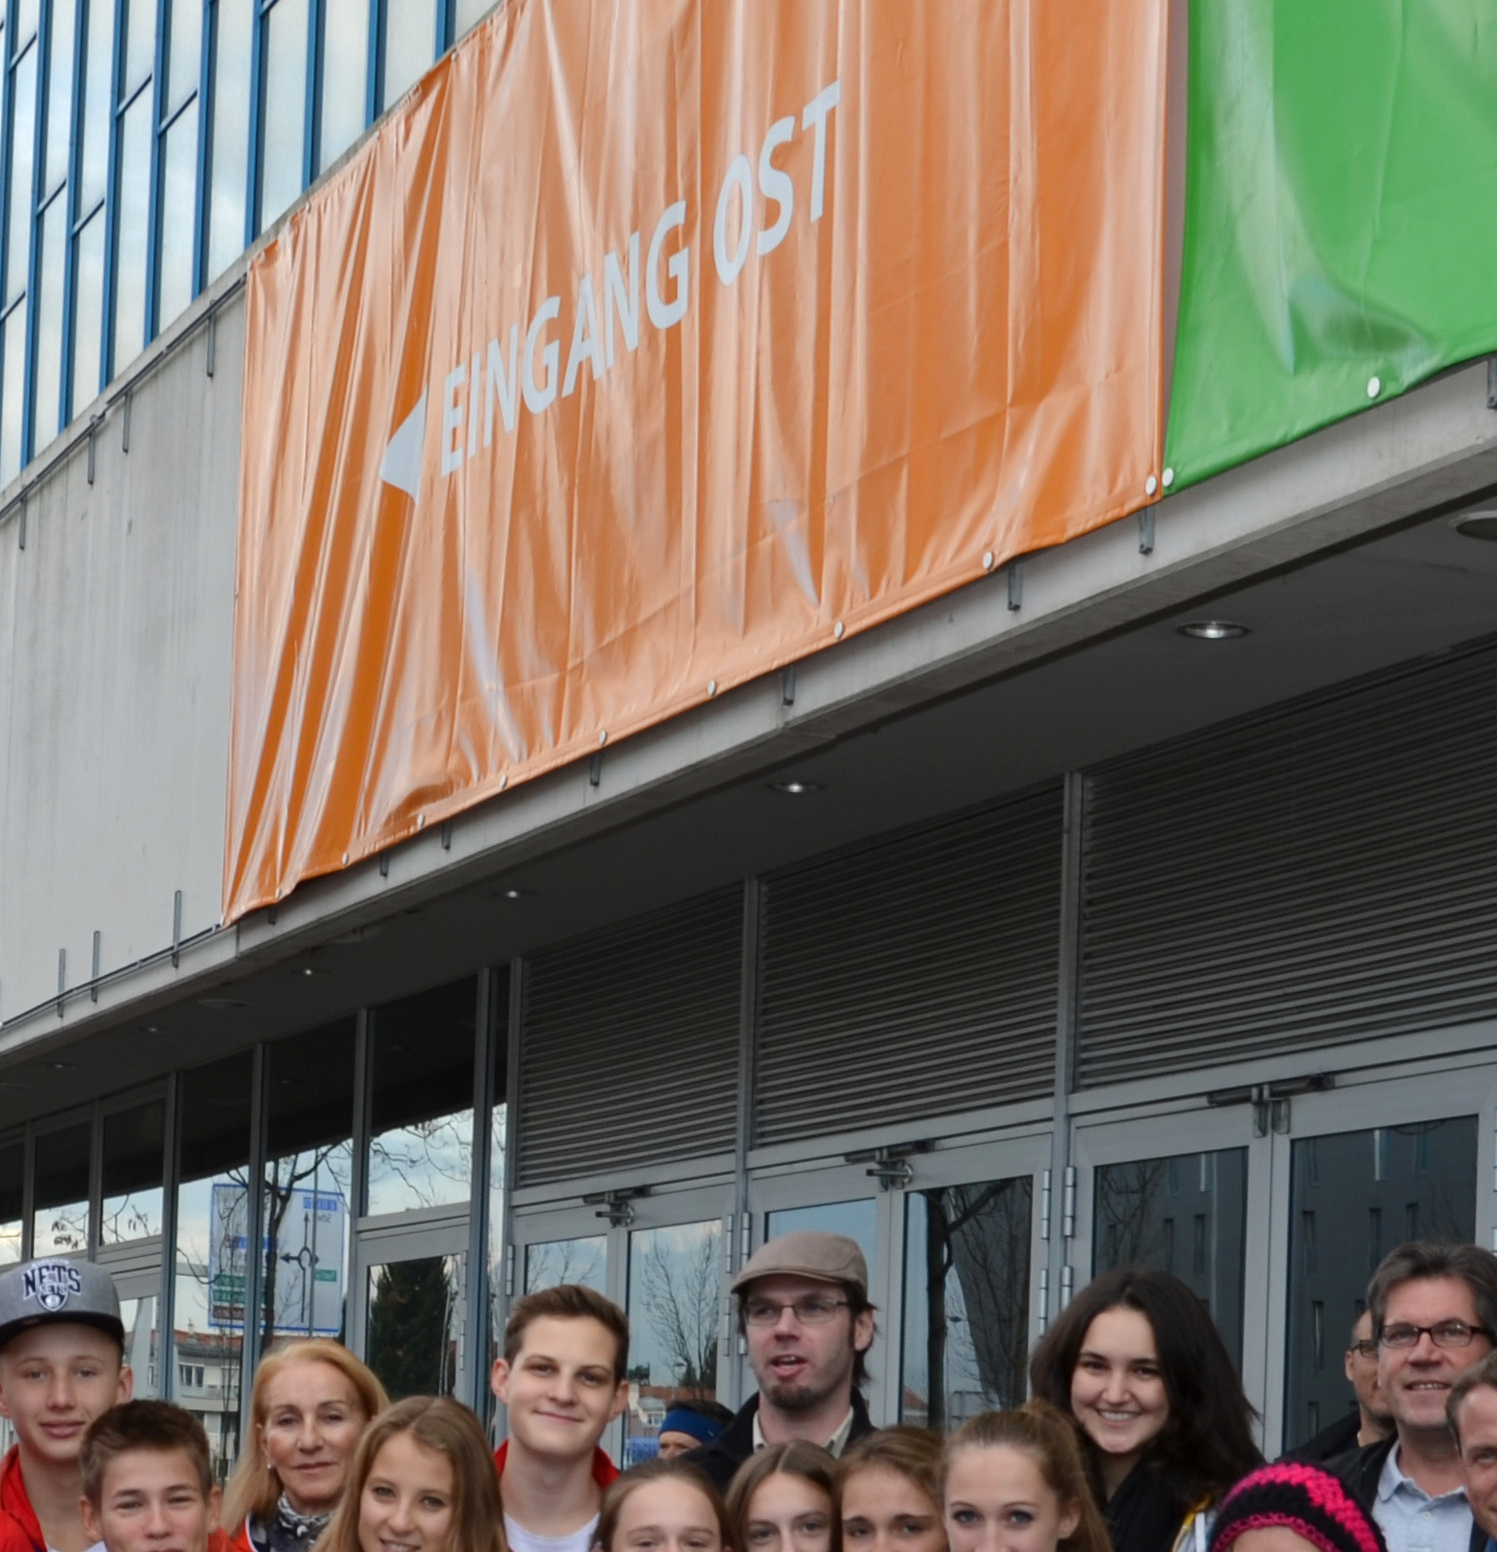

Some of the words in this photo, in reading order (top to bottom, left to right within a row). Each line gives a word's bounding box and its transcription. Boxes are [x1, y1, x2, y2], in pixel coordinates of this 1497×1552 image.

[440, 198, 690, 479] EINGANG
[713, 77, 841, 287] OST
[22, 1264, 82, 1300] NETS
